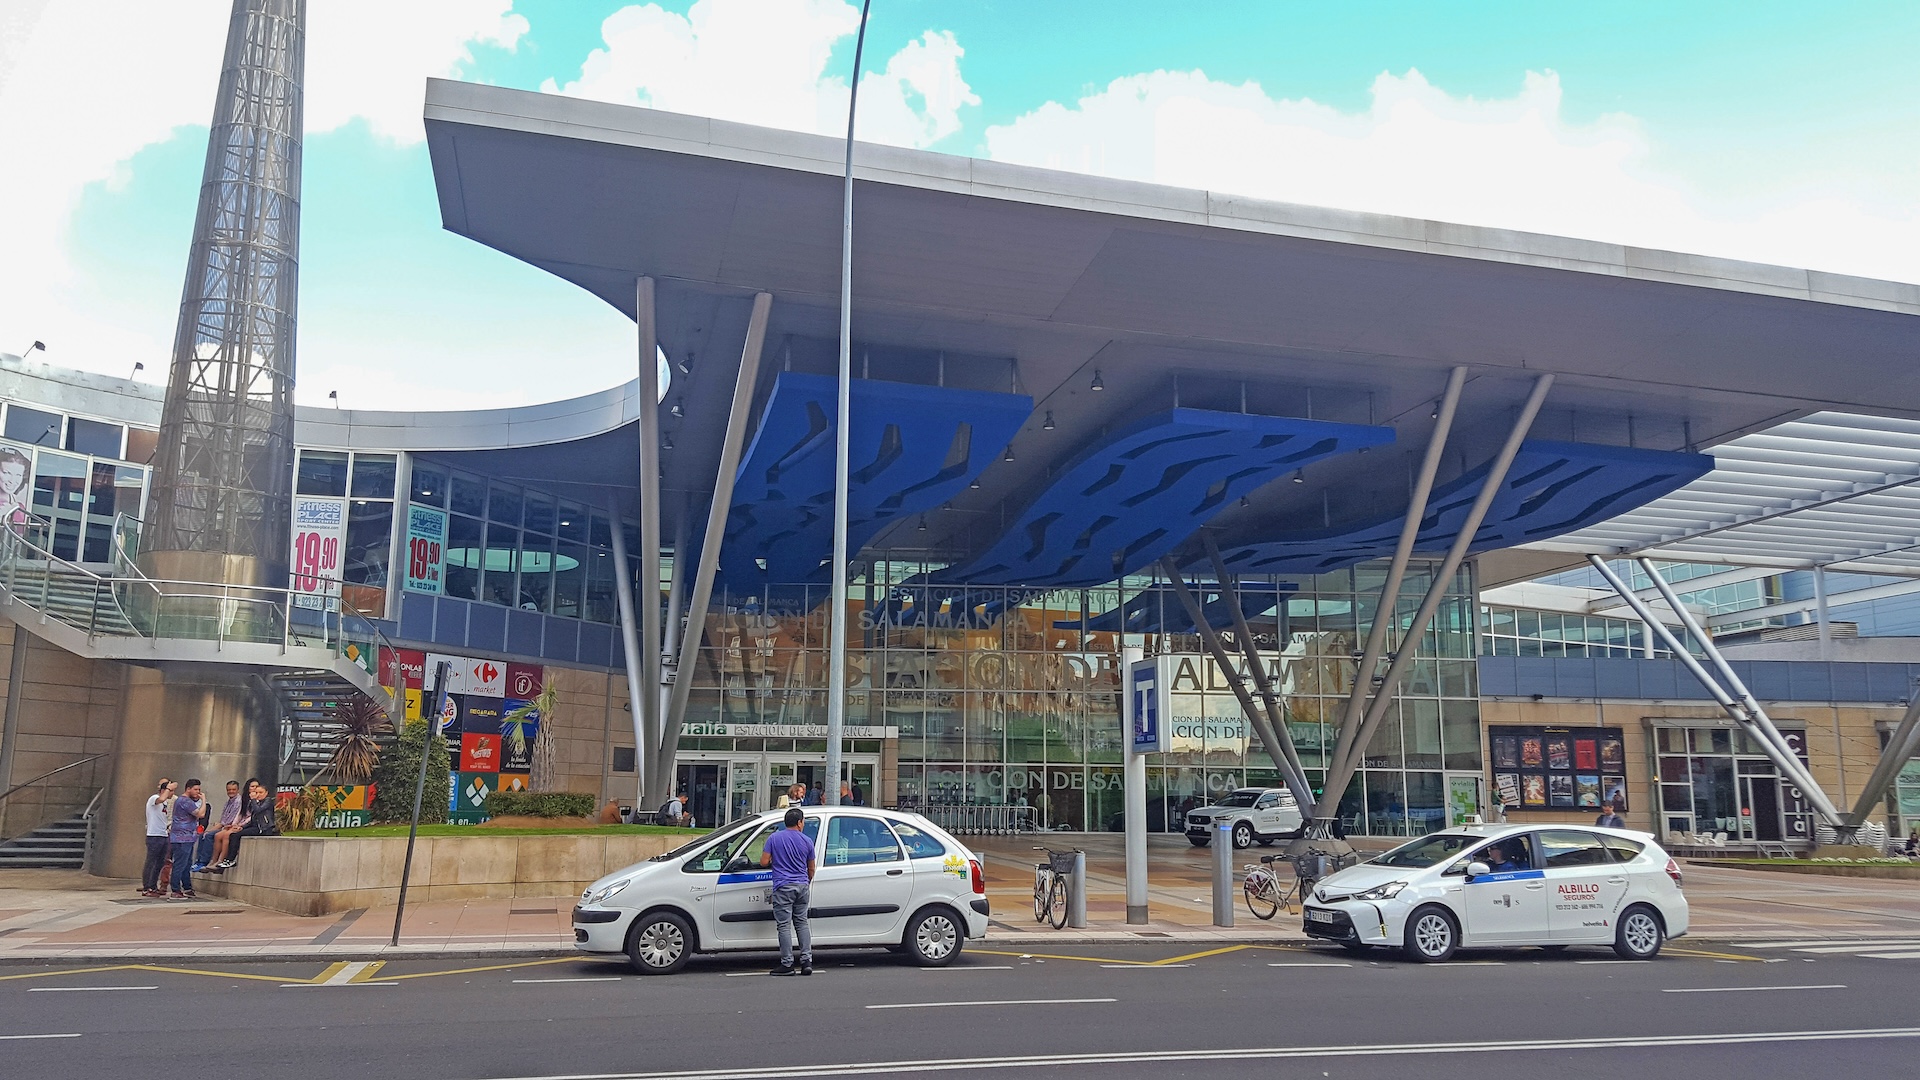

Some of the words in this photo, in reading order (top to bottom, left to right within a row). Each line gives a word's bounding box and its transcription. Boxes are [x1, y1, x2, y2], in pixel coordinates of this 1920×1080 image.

[298, 502, 340, 512] Fitness
[298, 511, 340, 520] PLACE
[411, 509, 442, 523] Fitness
[411, 519, 441, 531] PLACE
[982, 589, 1003, 603] DE
[1010, 589, 1120, 605] SALAMANCA
[857, 609, 1031, 631] SALAMANCA
[387, 661, 423, 672] VISONLAB
[473, 685, 496, 694] market
[789, 725, 804, 737] DE
[1053, 771, 1084, 790] DE
[315, 811, 361, 829] vialia
[1558, 884, 1599, 894] ALBILLO
